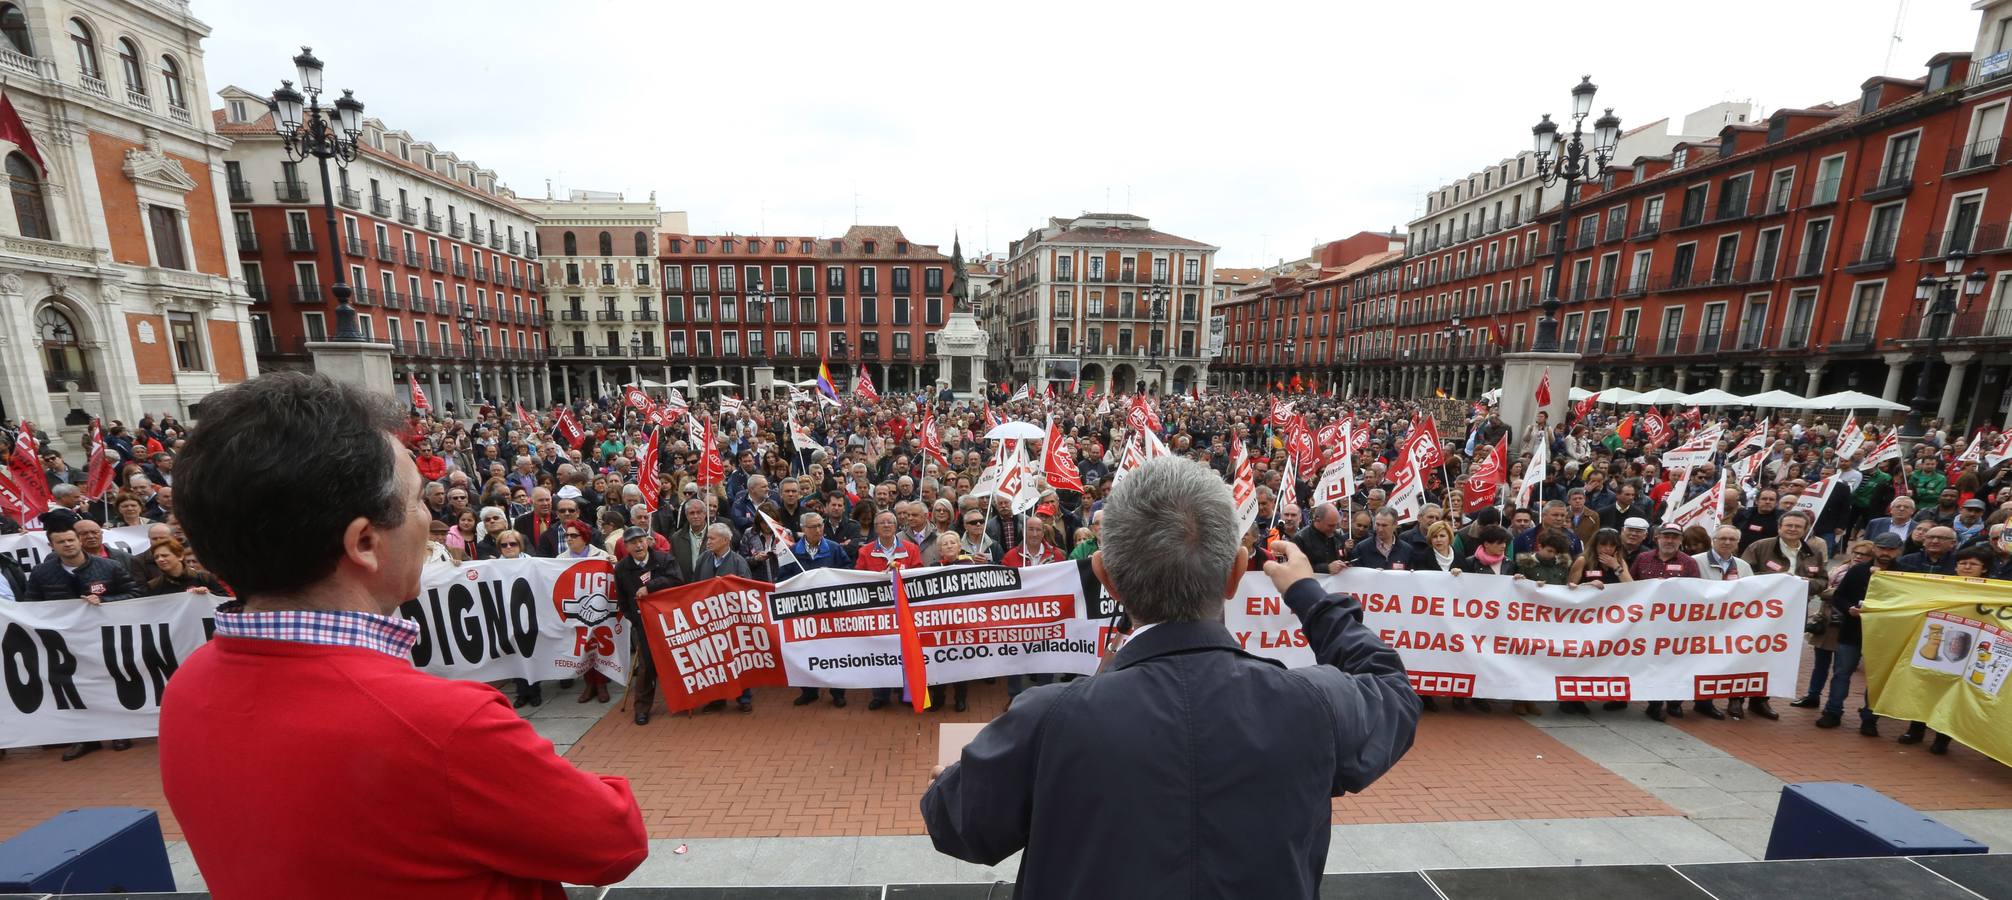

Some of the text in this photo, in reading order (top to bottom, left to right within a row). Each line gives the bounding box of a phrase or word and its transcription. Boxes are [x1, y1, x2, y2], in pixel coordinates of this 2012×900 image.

[775, 595, 815, 616] EMPLEO
[815, 593, 828, 609] DE
[926, 577, 939, 596] DE
[940, 574, 959, 593] LAS
[963, 570, 1016, 590] PENSIONES
[1246, 597, 1280, 615] EN
[1411, 595, 1445, 616] DE
[1453, 598, 1500, 619] LOS
[1507, 601, 1643, 624] SERVICIOS
[1650, 599, 1784, 622] PUBLICOS
[658, 589, 763, 637] LA CRISIS
[665, 613, 764, 647] TERMINA CUANDO HAYA
[793, 616, 818, 640] NO
[821, 617, 832, 633] AL
[834, 615, 876, 633] RECORTE
[878, 614, 891, 631] DE
[914, 606, 987, 628] SERVICIOS
[991, 601, 1061, 622] SOCIALES
[670, 625, 771, 675] EMPLEO
[934, 625, 1062, 646] Y LAS PENSIONES
[1236, 631, 1252, 650] Y
[1260, 628, 1309, 648] LAS
[1471, 635, 1486, 653] Y
[1494, 636, 1646, 658] EMPLEADOS
[1654, 634, 1788, 656] PUBLICOS
[101, 623, 179, 711] UN
[808, 653, 904, 671] Pensionistas
[935, 646, 993, 664] CC.OO.
[998, 643, 1018, 656] de
[1022, 638, 1096, 656] Valladolid
[682, 651, 776, 695] PARA TODOS
[1560, 681, 1627, 697] CCOO
[1699, 677, 1765, 696] CCOO
